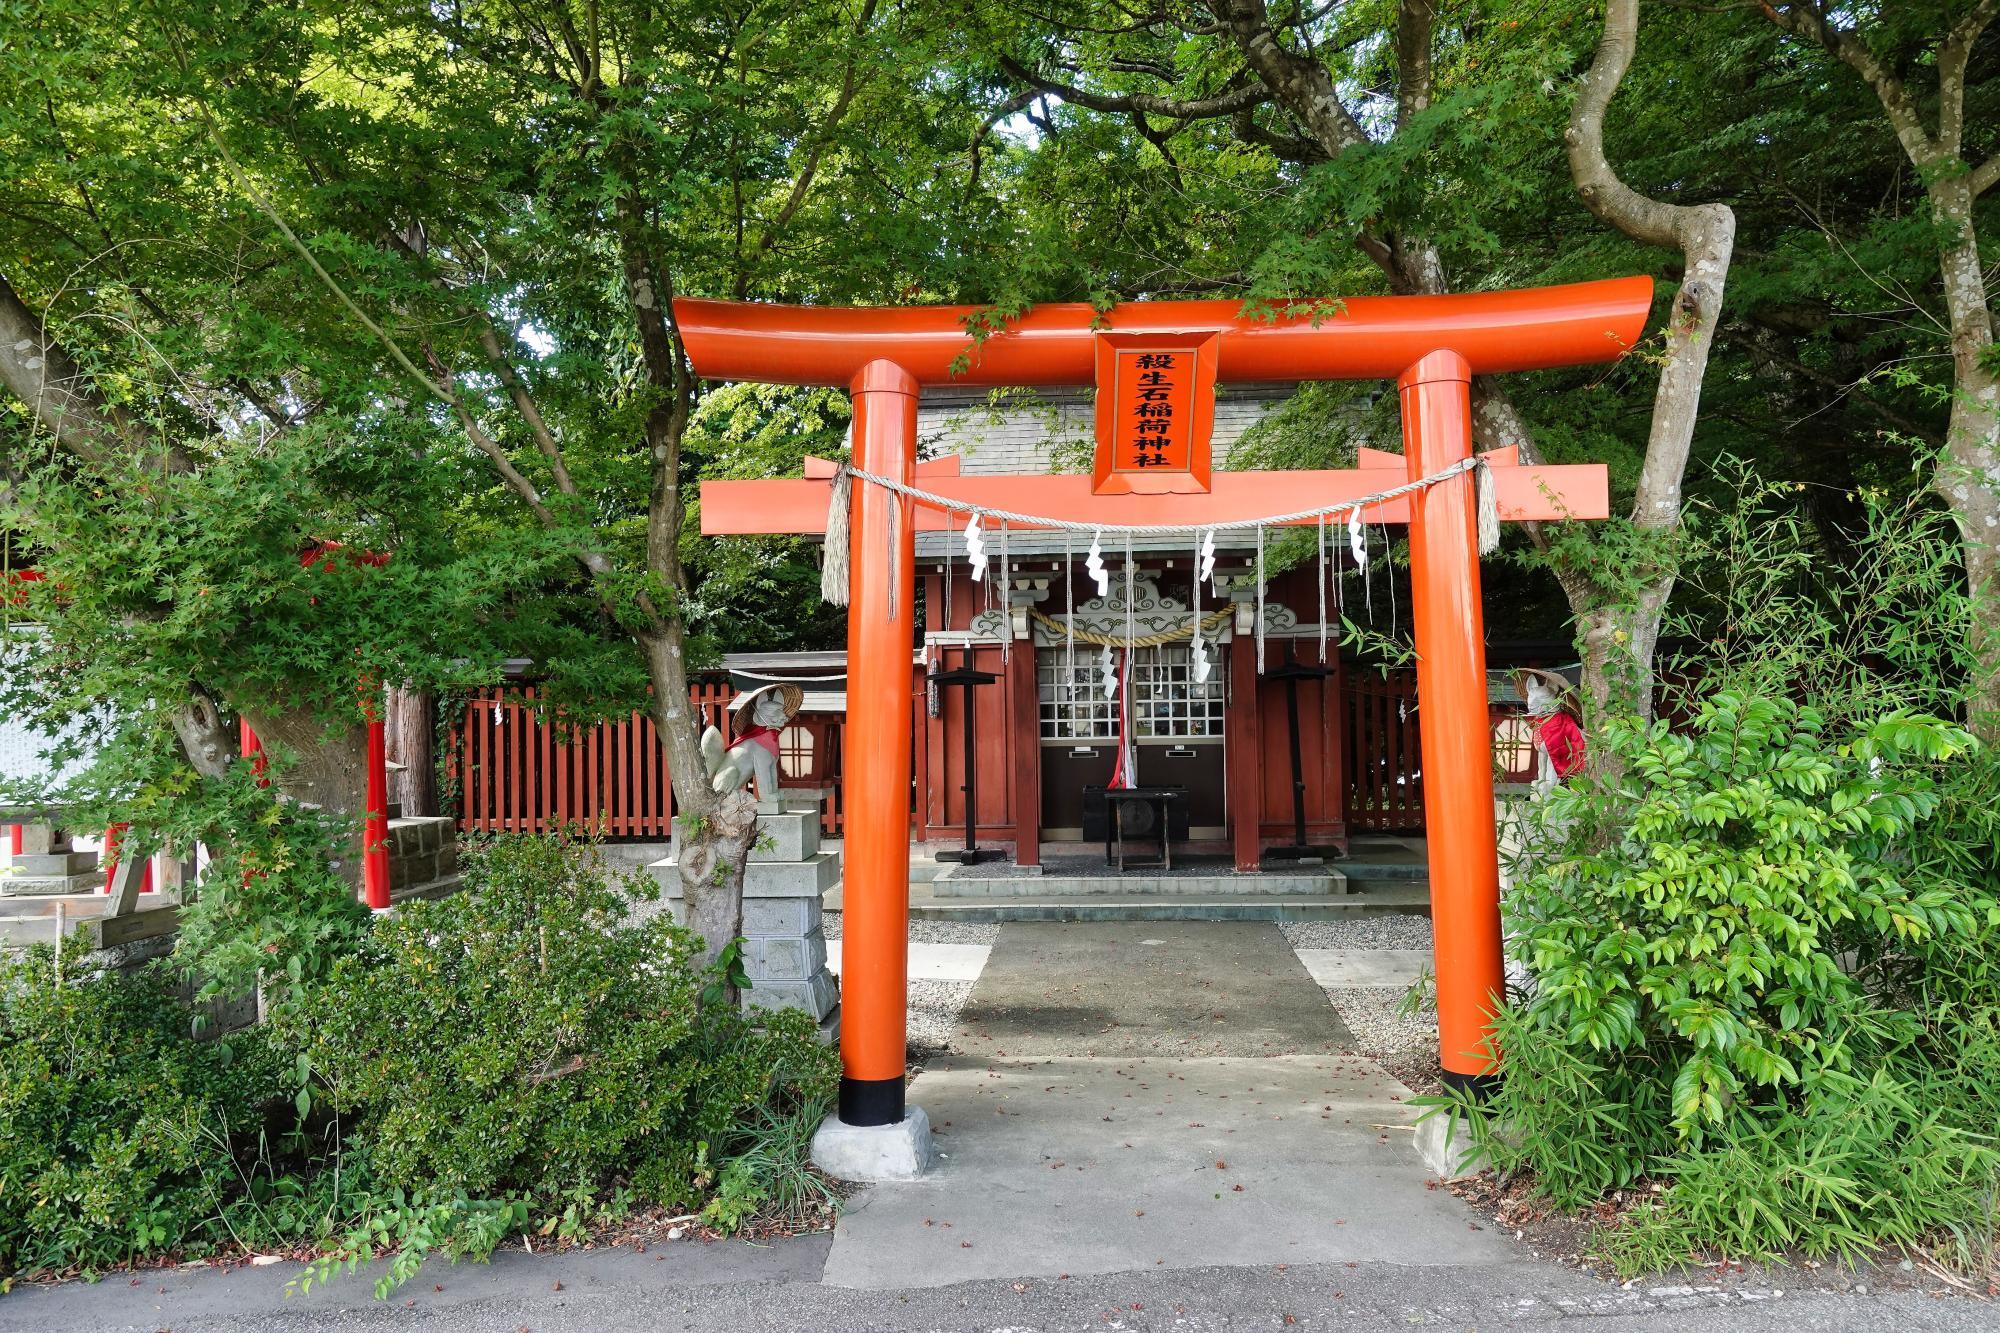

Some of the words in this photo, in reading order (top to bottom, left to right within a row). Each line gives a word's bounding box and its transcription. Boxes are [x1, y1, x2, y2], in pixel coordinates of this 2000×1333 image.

[1132, 354, 1176, 467] 殺生石稲荷神社
